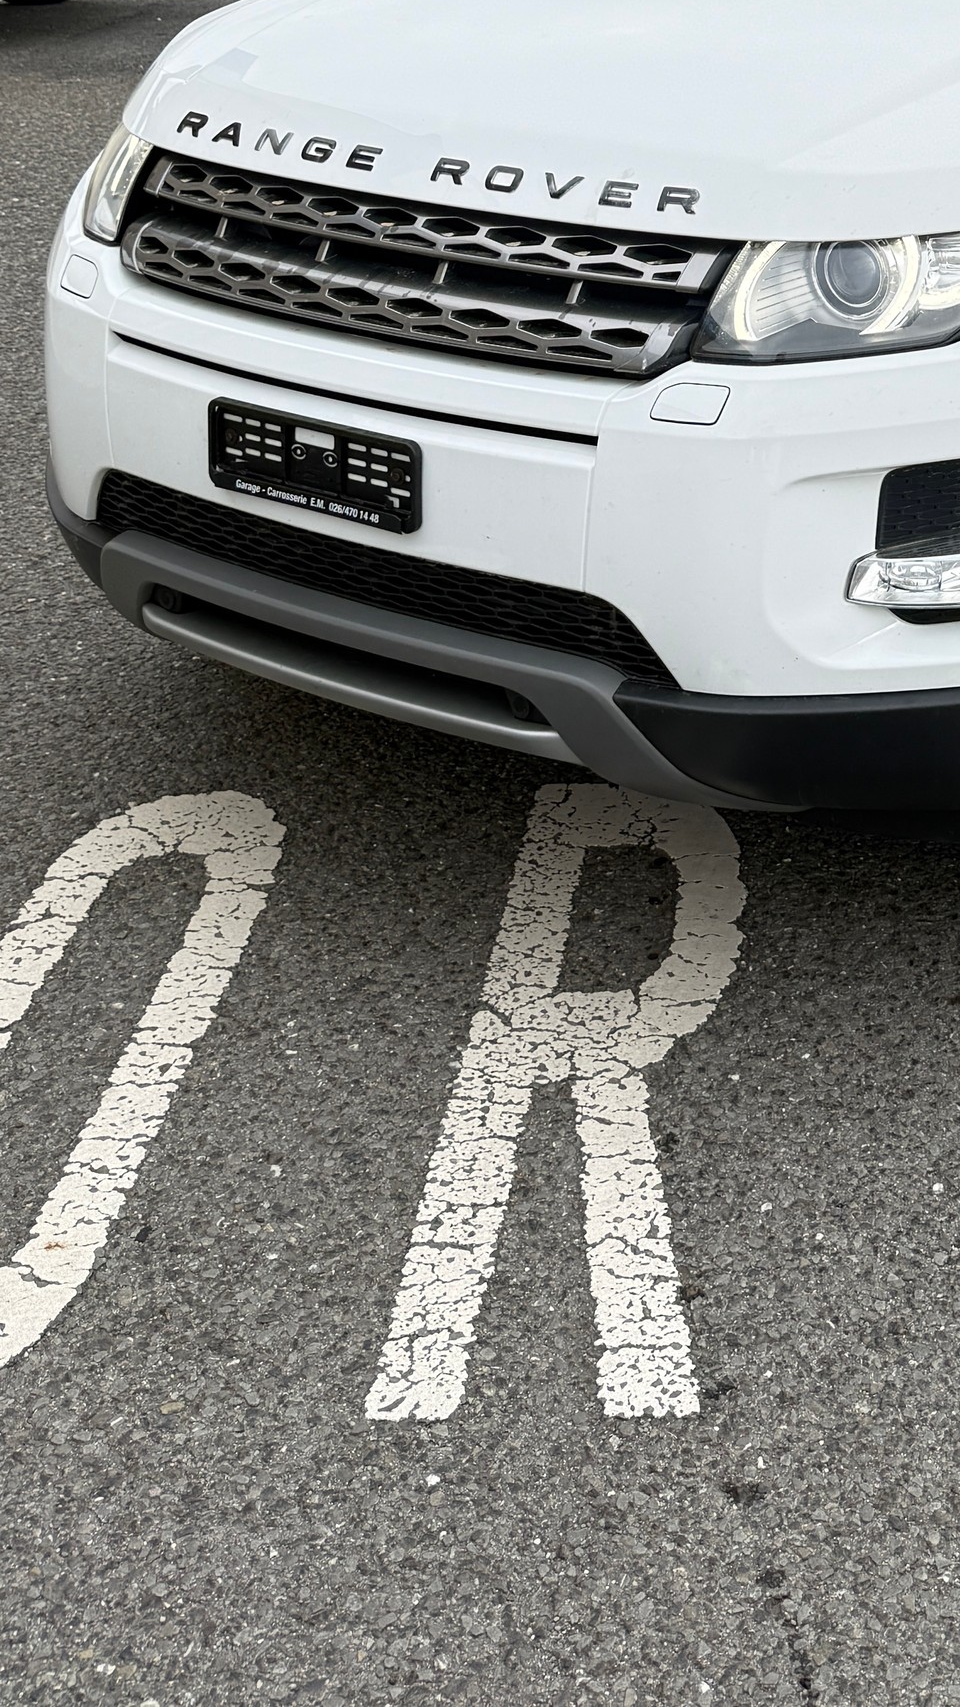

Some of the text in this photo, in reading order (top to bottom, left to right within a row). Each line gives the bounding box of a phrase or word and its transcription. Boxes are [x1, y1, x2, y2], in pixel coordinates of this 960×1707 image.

[176, 111, 700, 215] RANGE ROVER
[235, 478, 261, 494] Garage
[267, 487, 308, 504] Carrosserie
[310, 500, 326, 510] E.M.
[328, 503, 358, 518] 026/470
[359, 510, 369, 520] 14
[369, 513, 380, 523] 48
